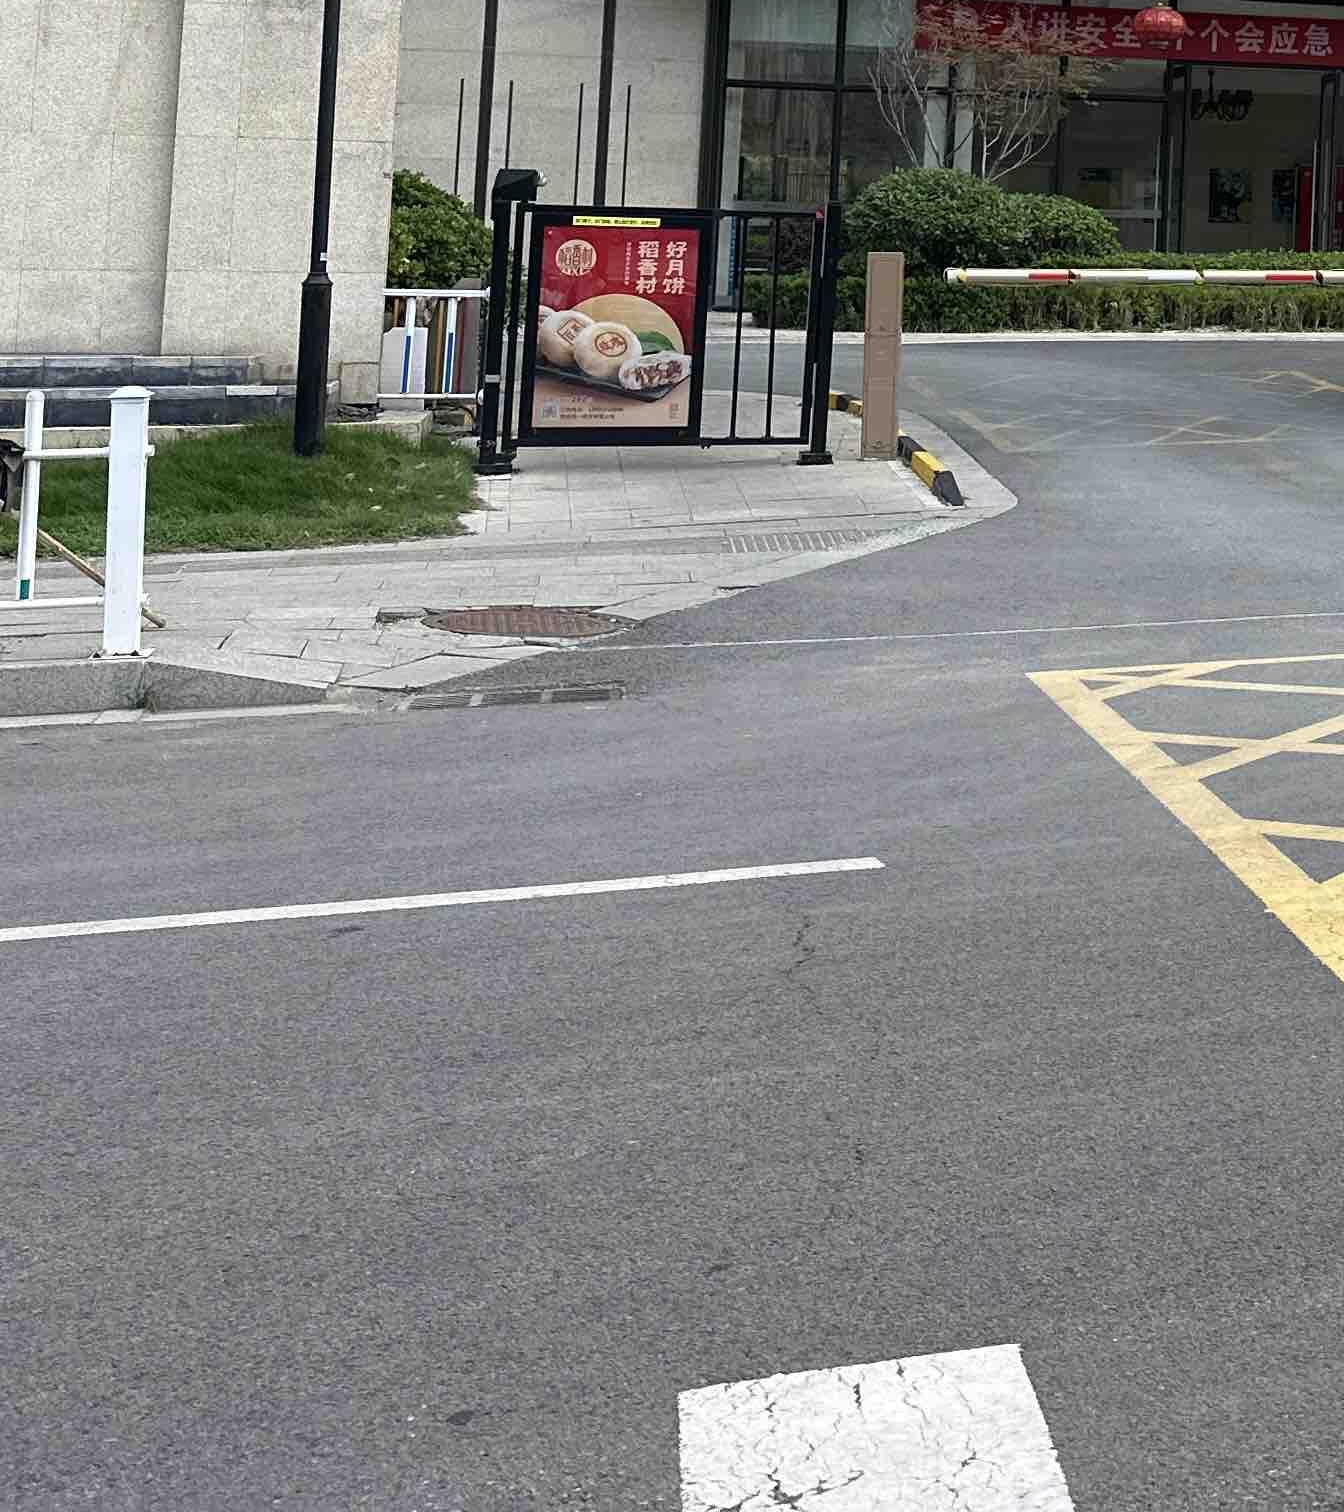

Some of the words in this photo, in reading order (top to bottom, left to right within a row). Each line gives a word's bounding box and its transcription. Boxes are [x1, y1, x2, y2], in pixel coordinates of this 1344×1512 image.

[635, 241, 660, 295] 稻香村
[662, 241, 688, 295] 好月饼
